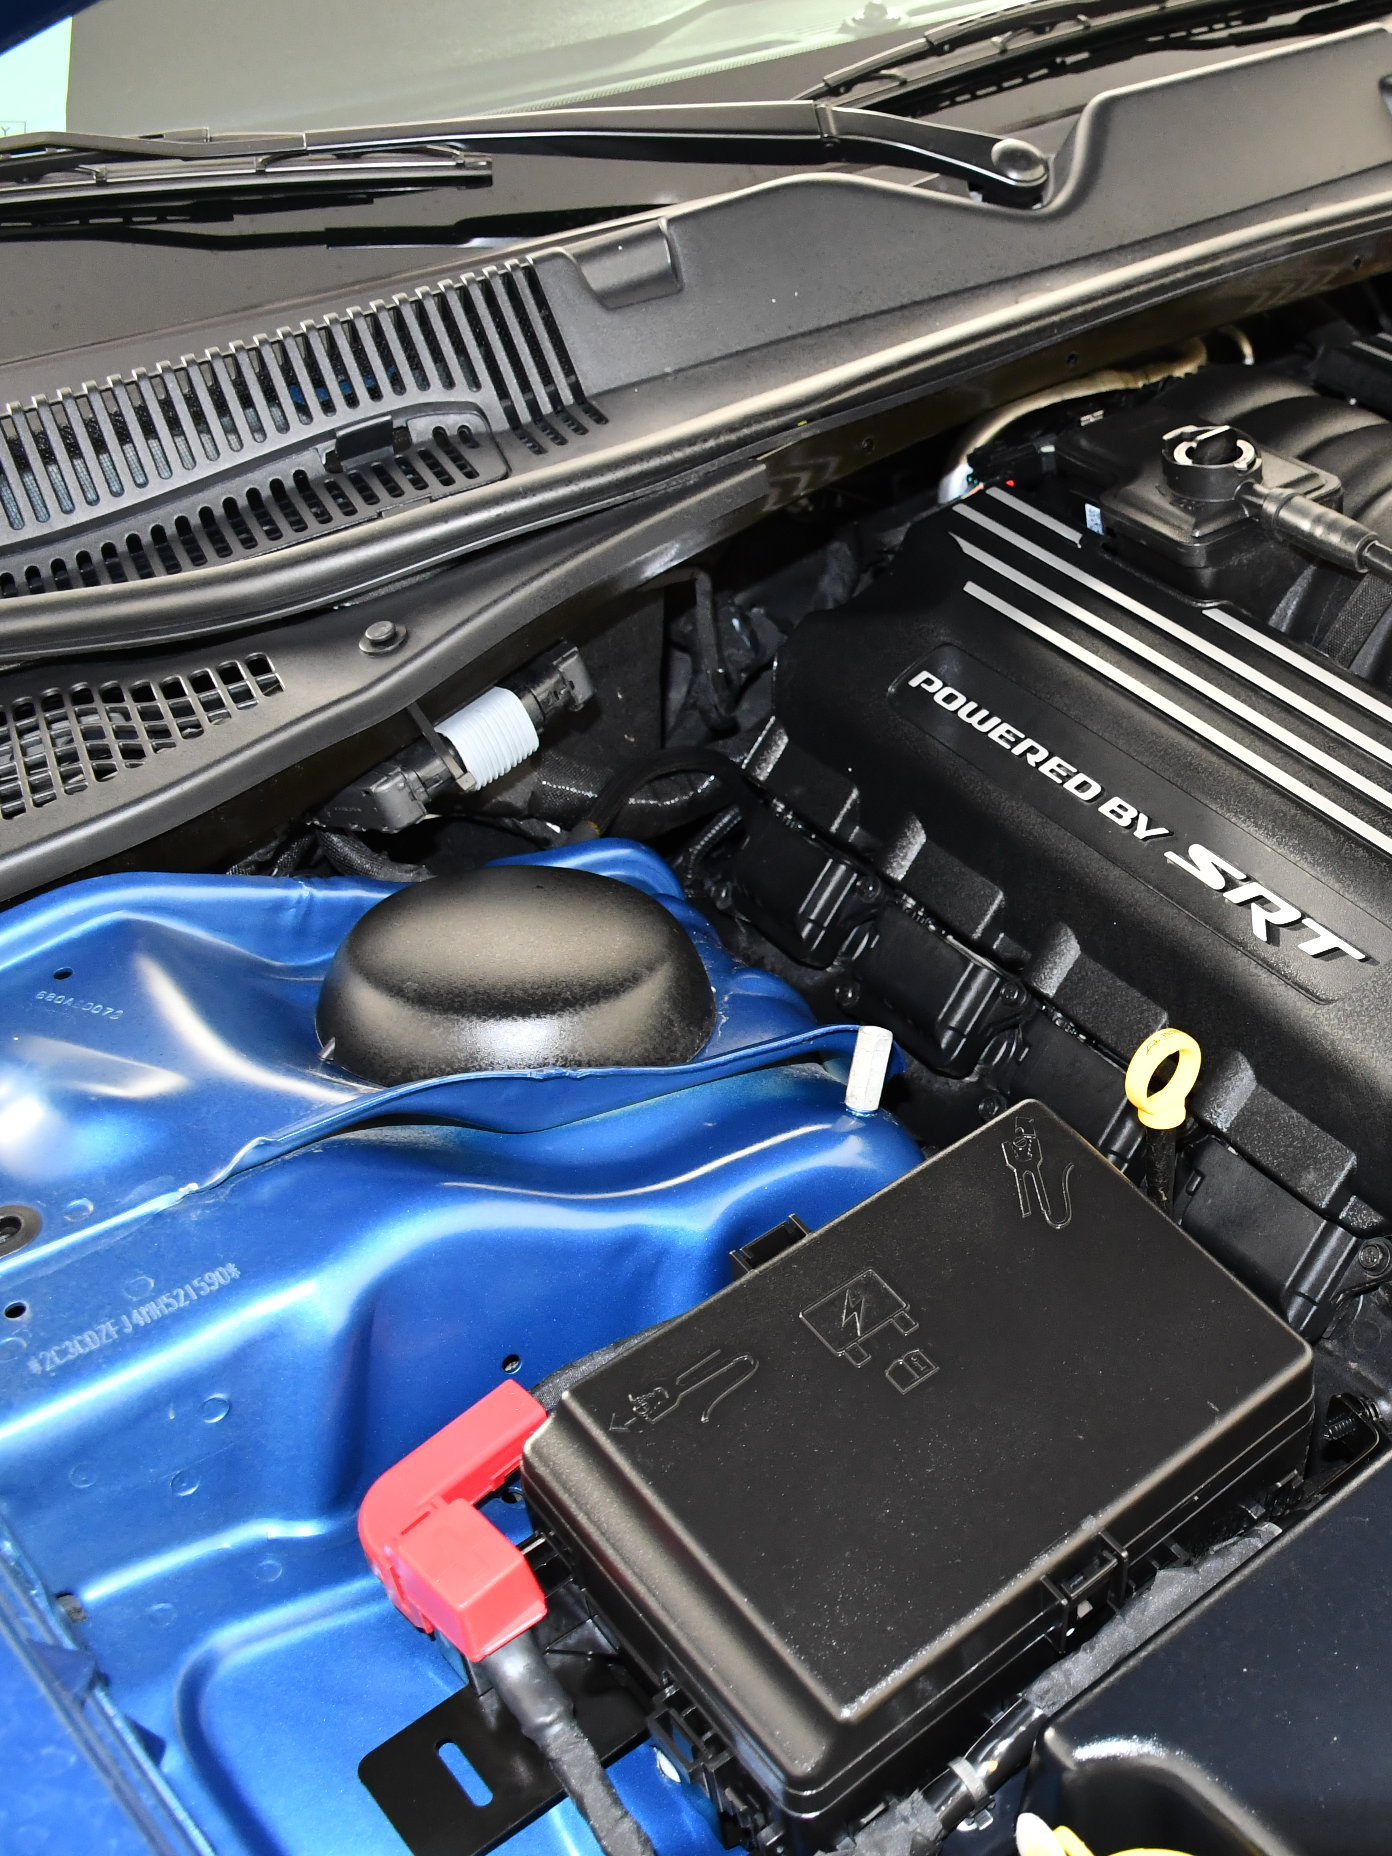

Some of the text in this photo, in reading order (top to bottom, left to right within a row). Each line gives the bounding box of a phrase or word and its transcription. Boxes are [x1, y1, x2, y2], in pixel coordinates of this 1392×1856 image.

[908, 670, 1368, 963] POWERED BY SRT
